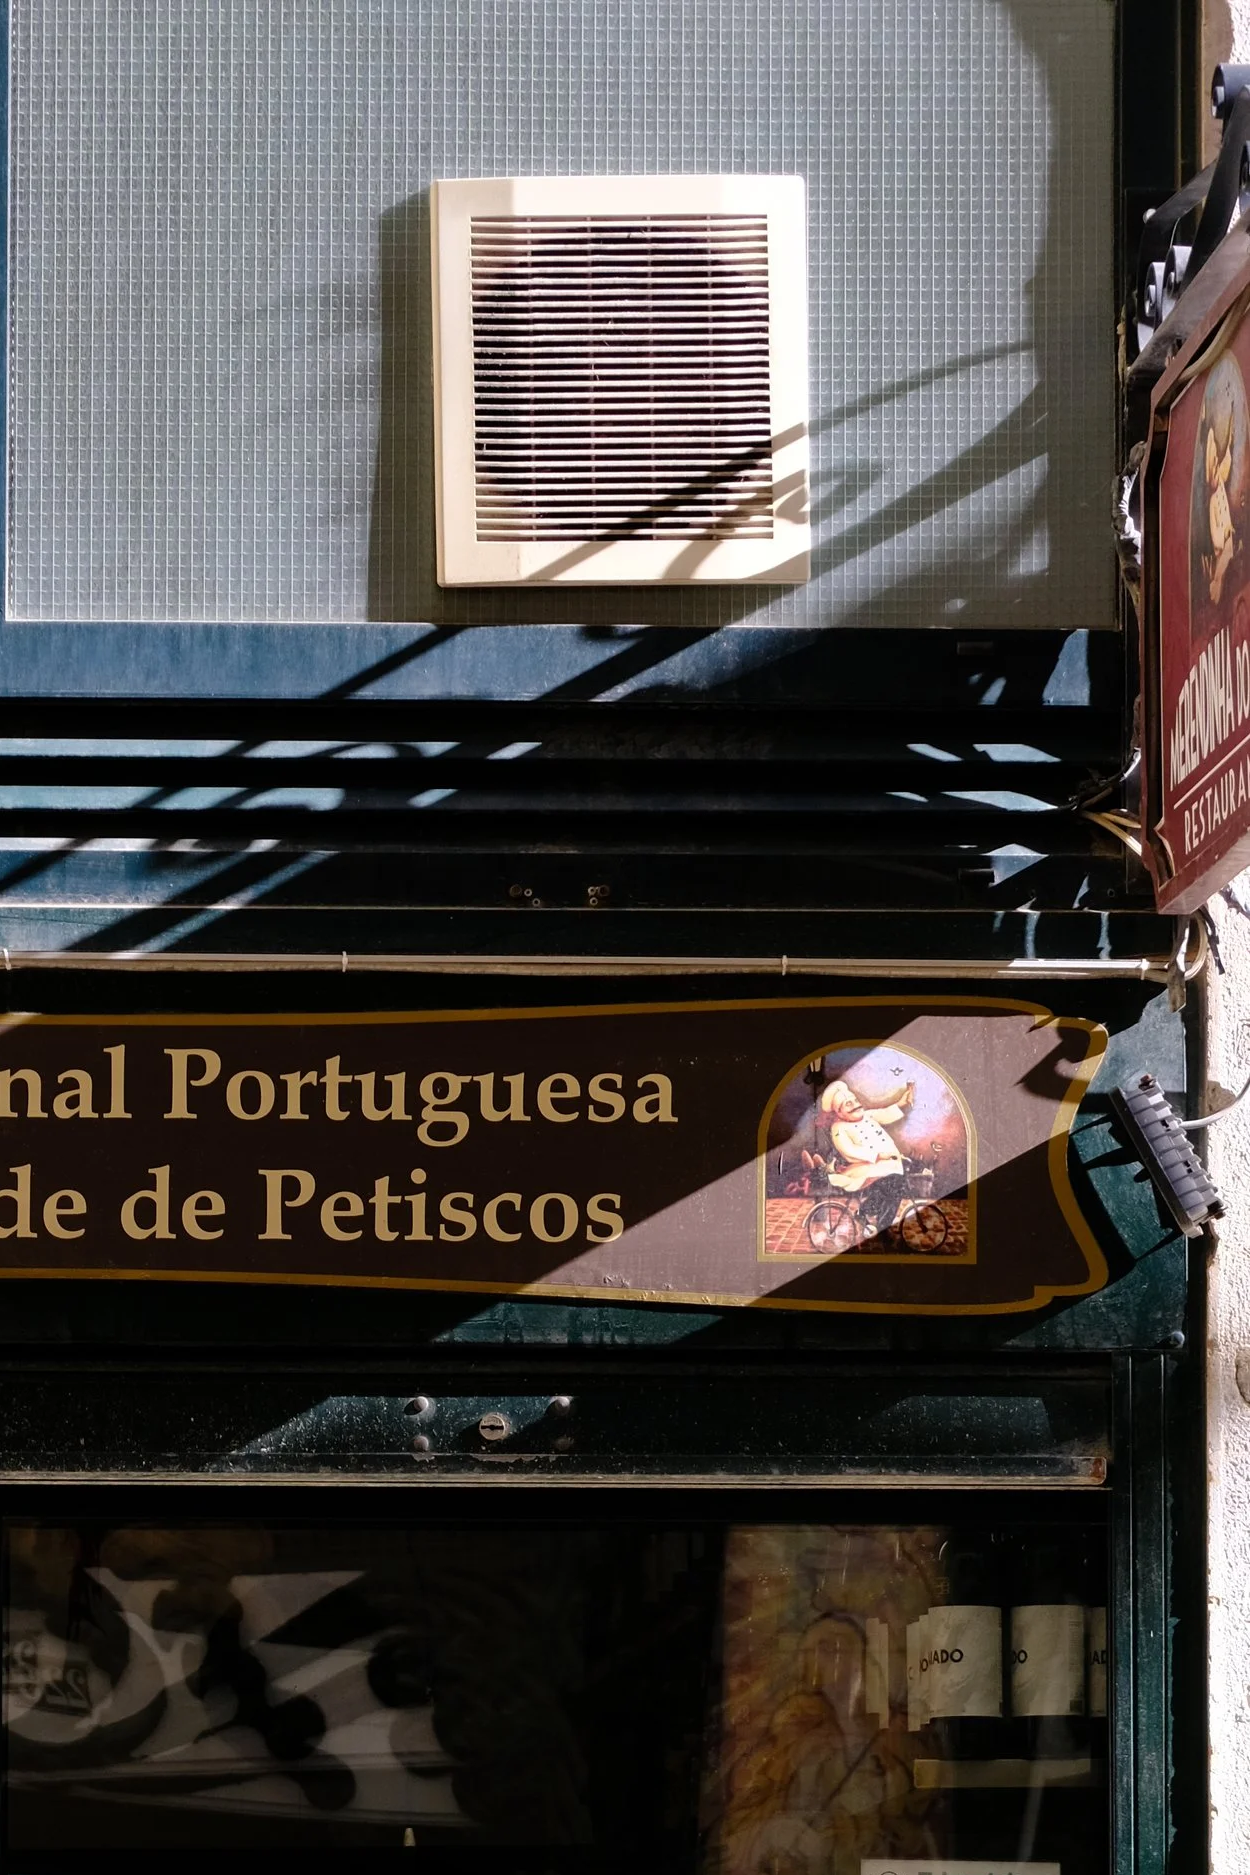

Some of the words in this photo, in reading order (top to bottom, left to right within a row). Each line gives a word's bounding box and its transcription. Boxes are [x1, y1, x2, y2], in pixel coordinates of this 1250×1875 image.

[1170, 626, 1235, 792] MERENDINHA
[163, 1047, 679, 1147] Portuguesa
[120, 1164, 226, 1240] de
[258, 1168, 625, 1243] Petiscos
